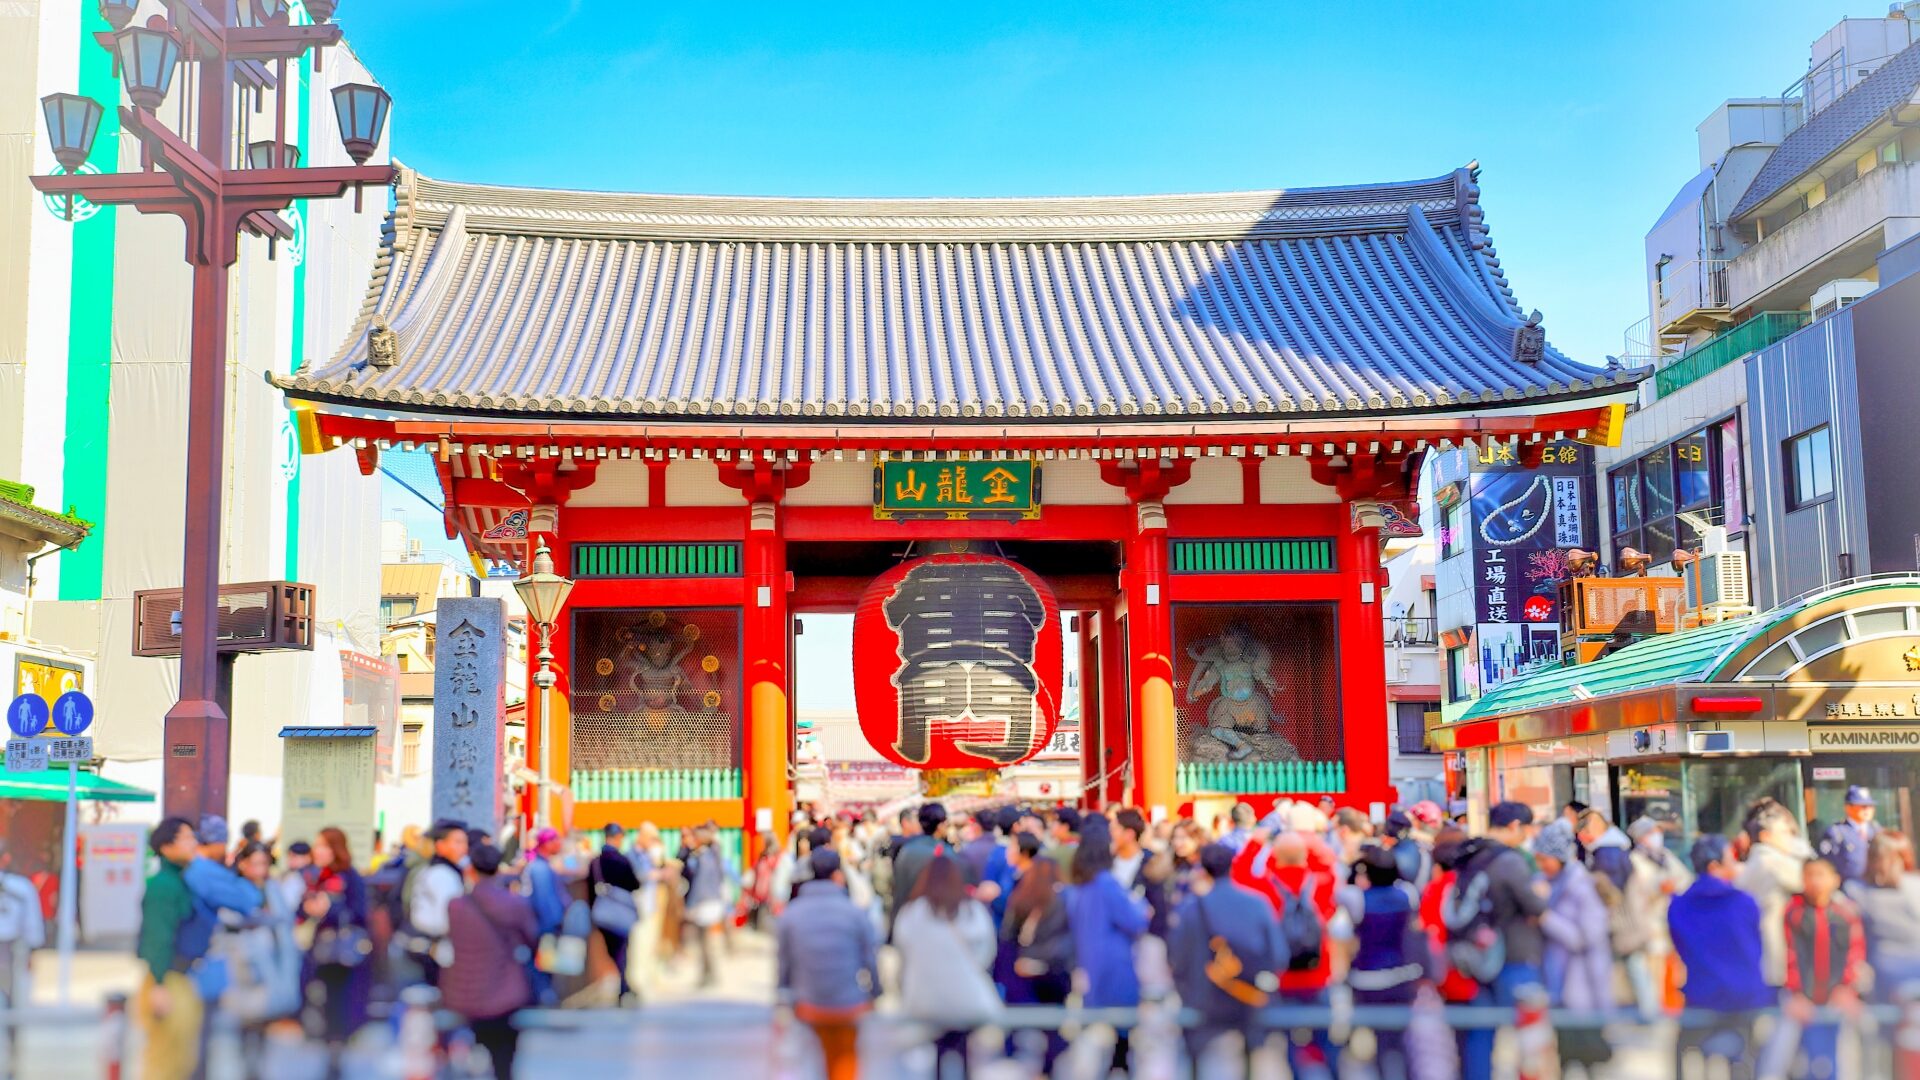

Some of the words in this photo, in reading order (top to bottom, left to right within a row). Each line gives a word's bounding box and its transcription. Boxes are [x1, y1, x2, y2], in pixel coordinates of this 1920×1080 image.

[895, 466, 1018, 503] 金龍山
[1479, 446, 1577, 464] 山本石館
[1556, 482, 1568, 544] 日本真珠
[1567, 480, 1579, 544] 日本血赤珊瑚
[1484, 549, 1510, 623] 工場直送
[882, 563, 1046, 764] 雷門
[1820, 732, 1919, 745] KAMINARIMO
